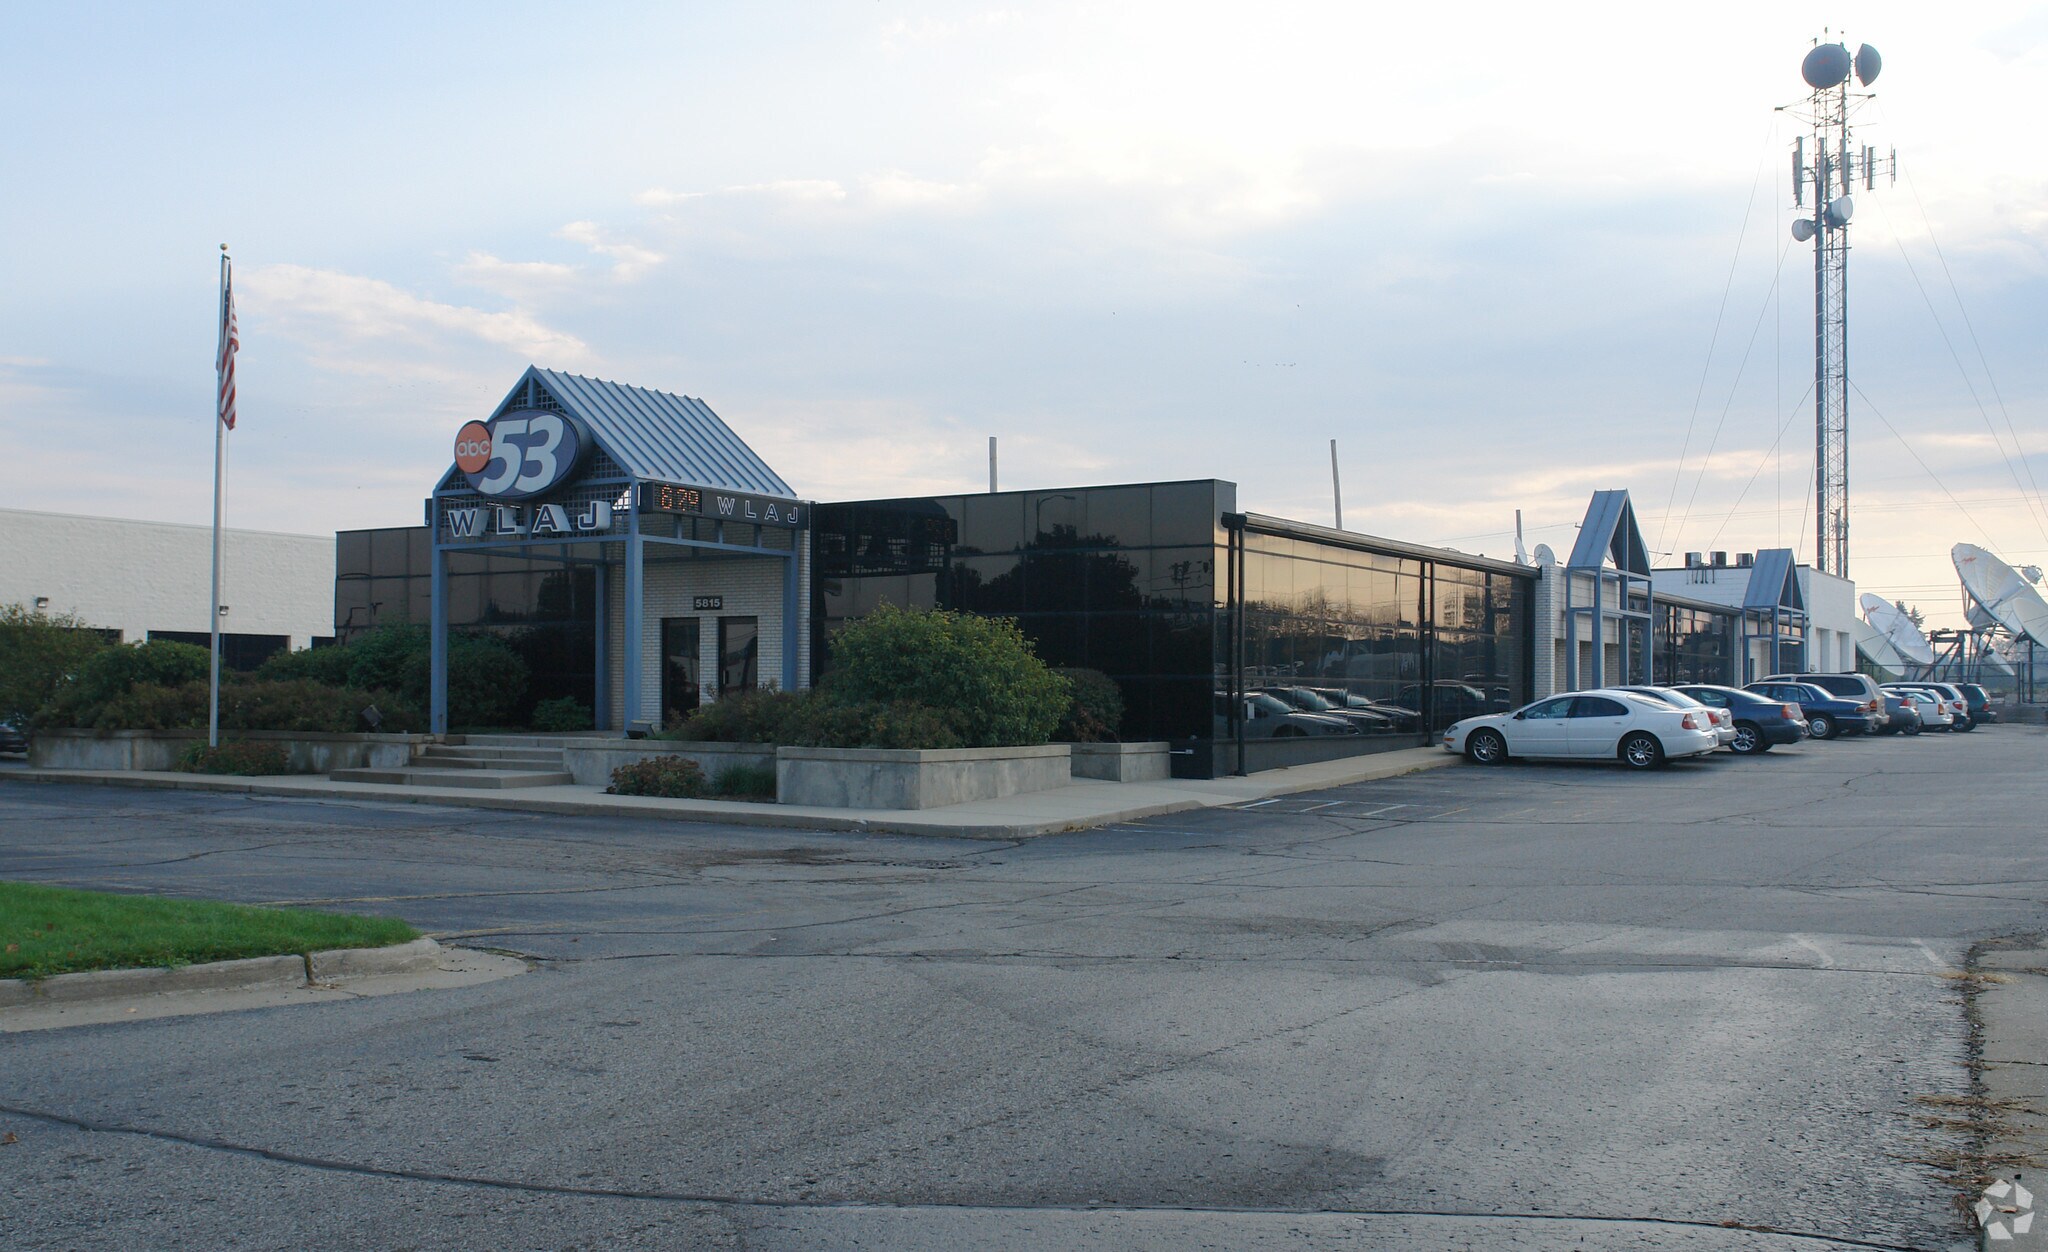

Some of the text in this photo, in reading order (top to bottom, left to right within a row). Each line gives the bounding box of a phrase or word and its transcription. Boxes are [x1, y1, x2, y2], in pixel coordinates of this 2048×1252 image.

[456, 414, 564, 494] abc 53
[447, 500, 602, 538] WLAJ
[716, 496, 799, 524] WLAJ
[695, 598, 721, 608] 5815
